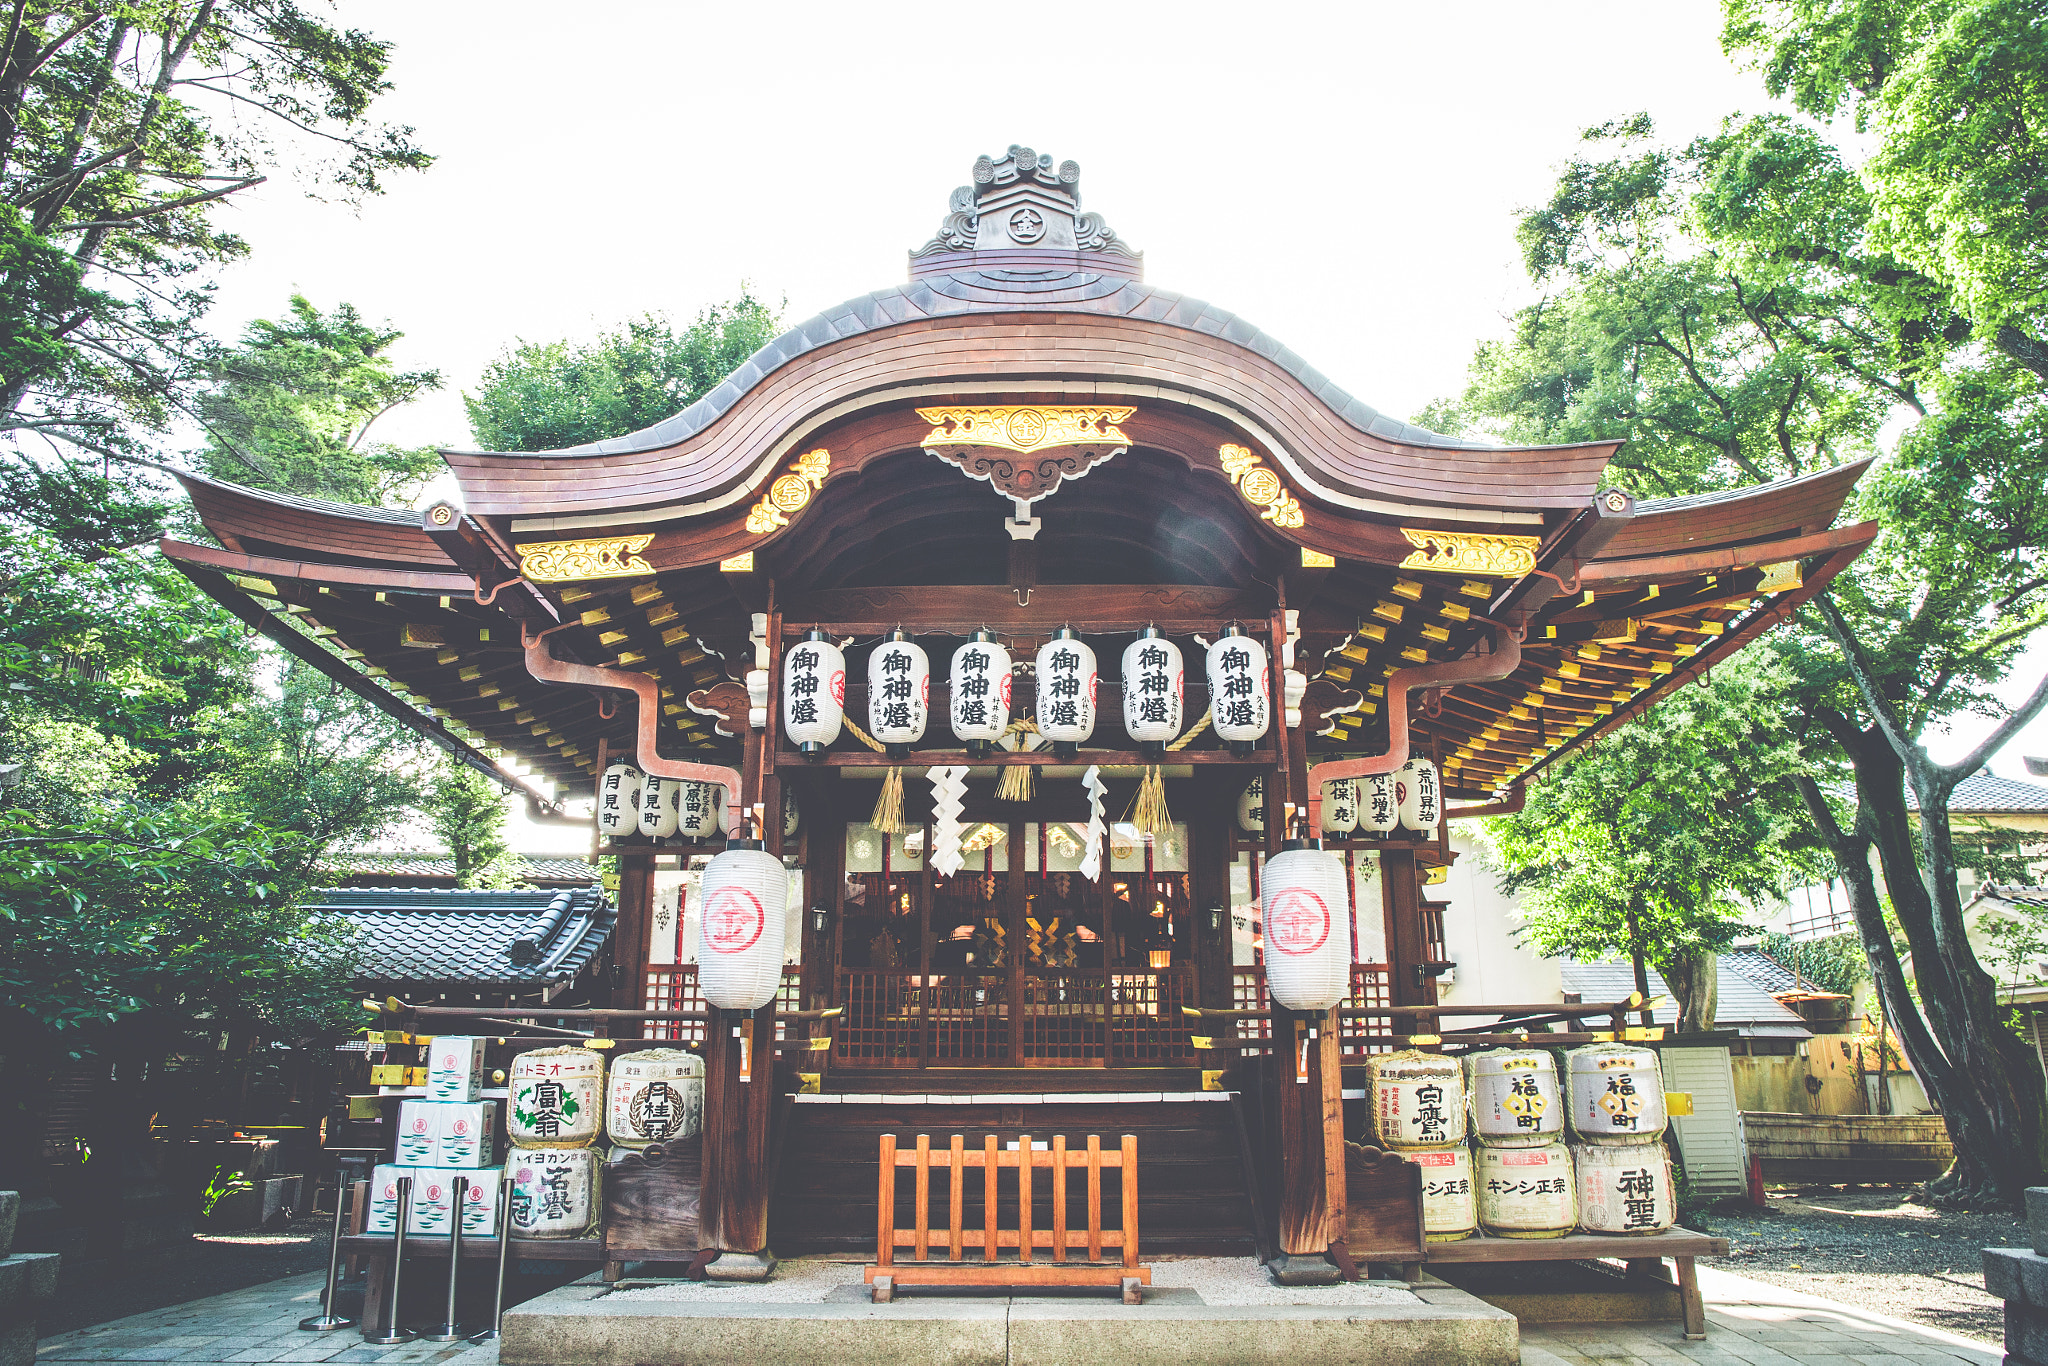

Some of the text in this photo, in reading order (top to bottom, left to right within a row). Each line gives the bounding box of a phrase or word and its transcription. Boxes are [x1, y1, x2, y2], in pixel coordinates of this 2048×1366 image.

[1010, 208, 1043, 238] 金
[1012, 411, 1041, 444] 金
[774, 475, 806, 510] 金
[1246, 471, 1276, 503] 金
[790, 647, 820, 725] 御神燈
[881, 648, 913, 729] 御神燈
[959, 647, 991, 726] 御神燈
[1049, 647, 1081, 726] 御神燈
[1138, 644, 1170, 724] 御神燈
[1219, 646, 1256, 727] 御神燈
[603, 774, 622, 828] 月見町
[644, 776, 662, 827] 月見町
[1417, 767, 1435, 823] 荒川昇治
[707, 892, 757, 944] 金
[1273, 893, 1323, 945] 金
[525, 1062, 576, 1076] トミオー
[530, 1078, 564, 1137] 富翁
[642, 1081, 671, 1142] 月桂冠
[1411, 1083, 1448, 1141] 白鷹
[1511, 1073, 1543, 1132] 福小町
[1606, 1073, 1639, 1131] 福小町
[517, 1153, 571, 1164] イヨカン
[1487, 1176, 1566, 1196] キンシ正宗
[1421, 1178, 1469, 1196] シ正宗
[1615, 1167, 1661, 1230] 神聖
